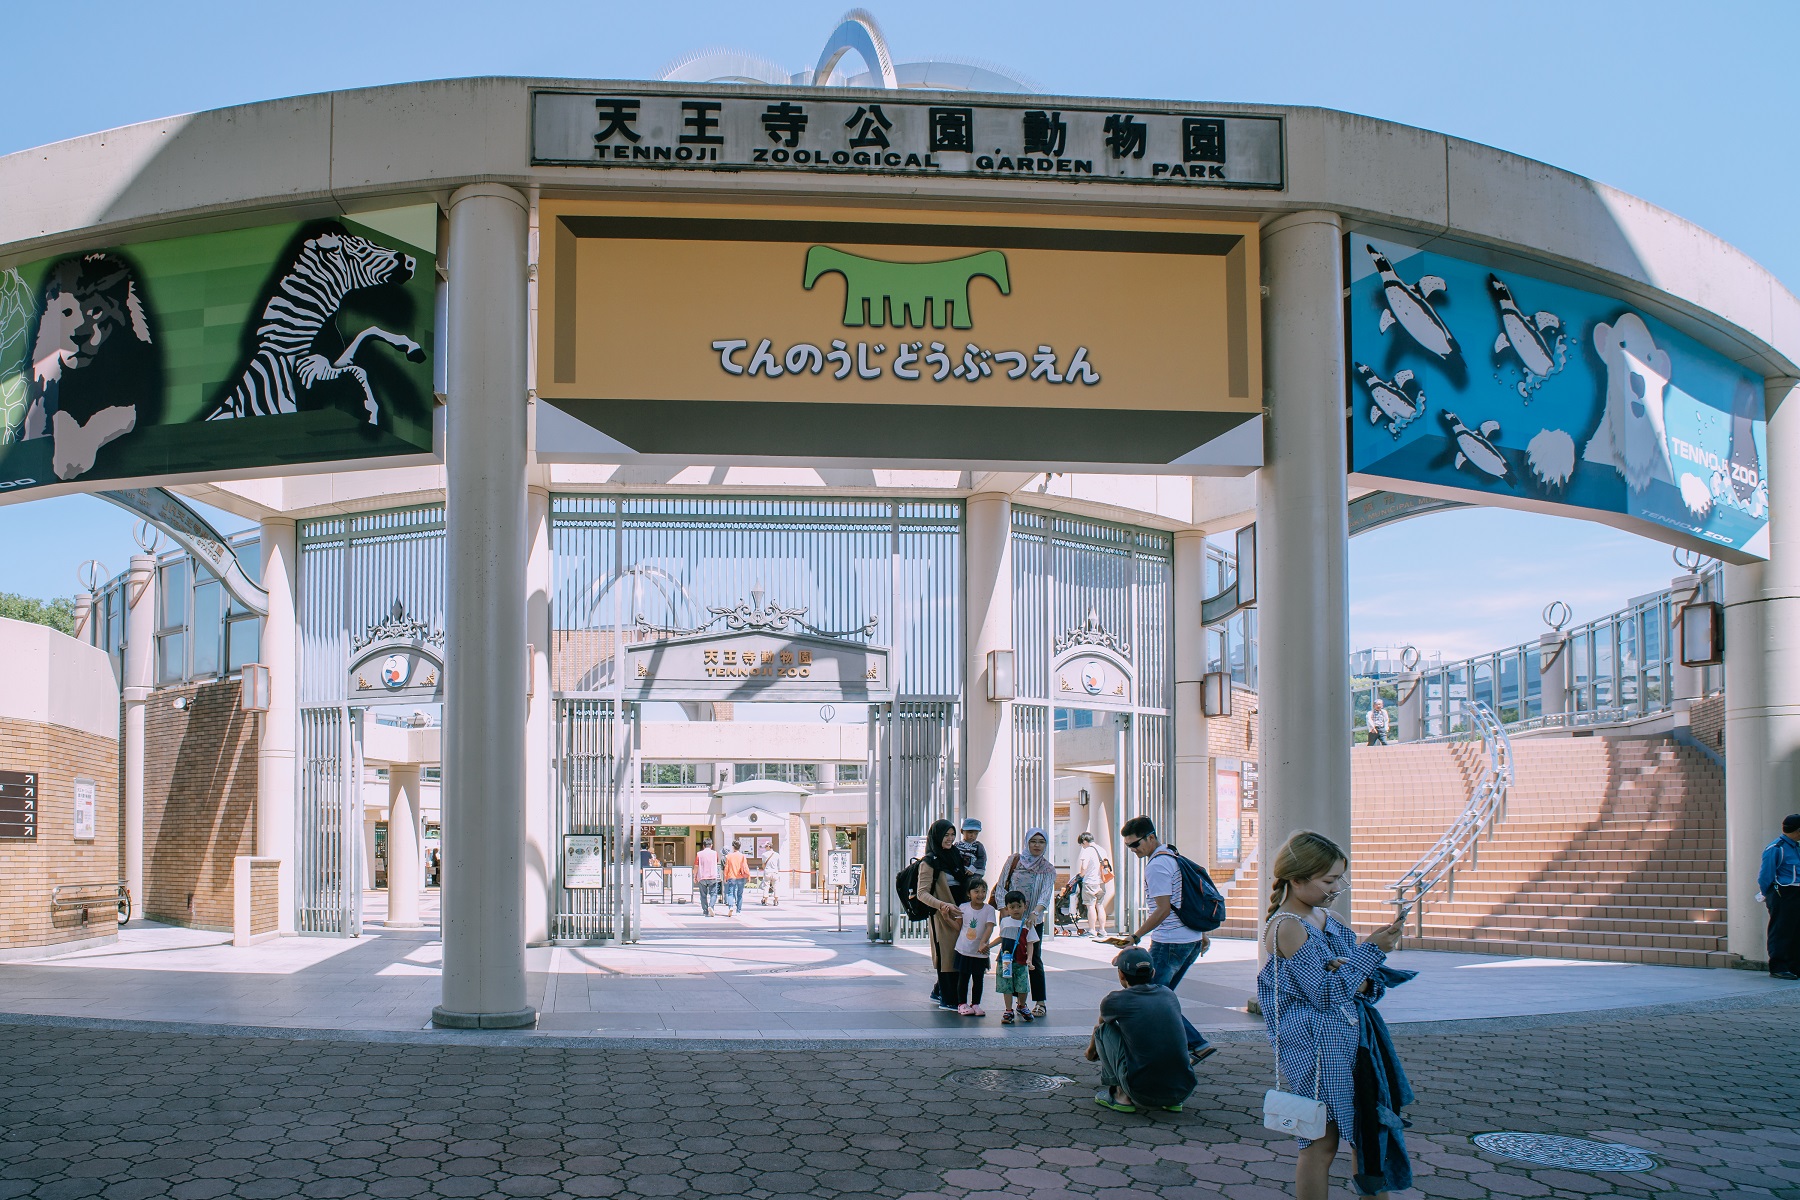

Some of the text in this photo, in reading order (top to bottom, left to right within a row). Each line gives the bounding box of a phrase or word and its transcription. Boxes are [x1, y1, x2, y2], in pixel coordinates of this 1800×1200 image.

[594, 98, 1227, 164] 天王寺公園動物園
[594, 144, 1226, 179] TENNOJI ZOOLOGICAL GARDEN PARK
[711, 338, 1101, 386] てんのうじどうぶつえん
[1671, 436, 1759, 488] TENNOJI ZOO
[1367, 502, 1415, 520] MUNICIPAL
[1641, 508, 1734, 544] TENNOJI ZOO
[196, 539, 221, 565] STATION
[703, 649, 812, 666] 天王寺動物園
[705, 667, 811, 678] TENNOJI ZOO
